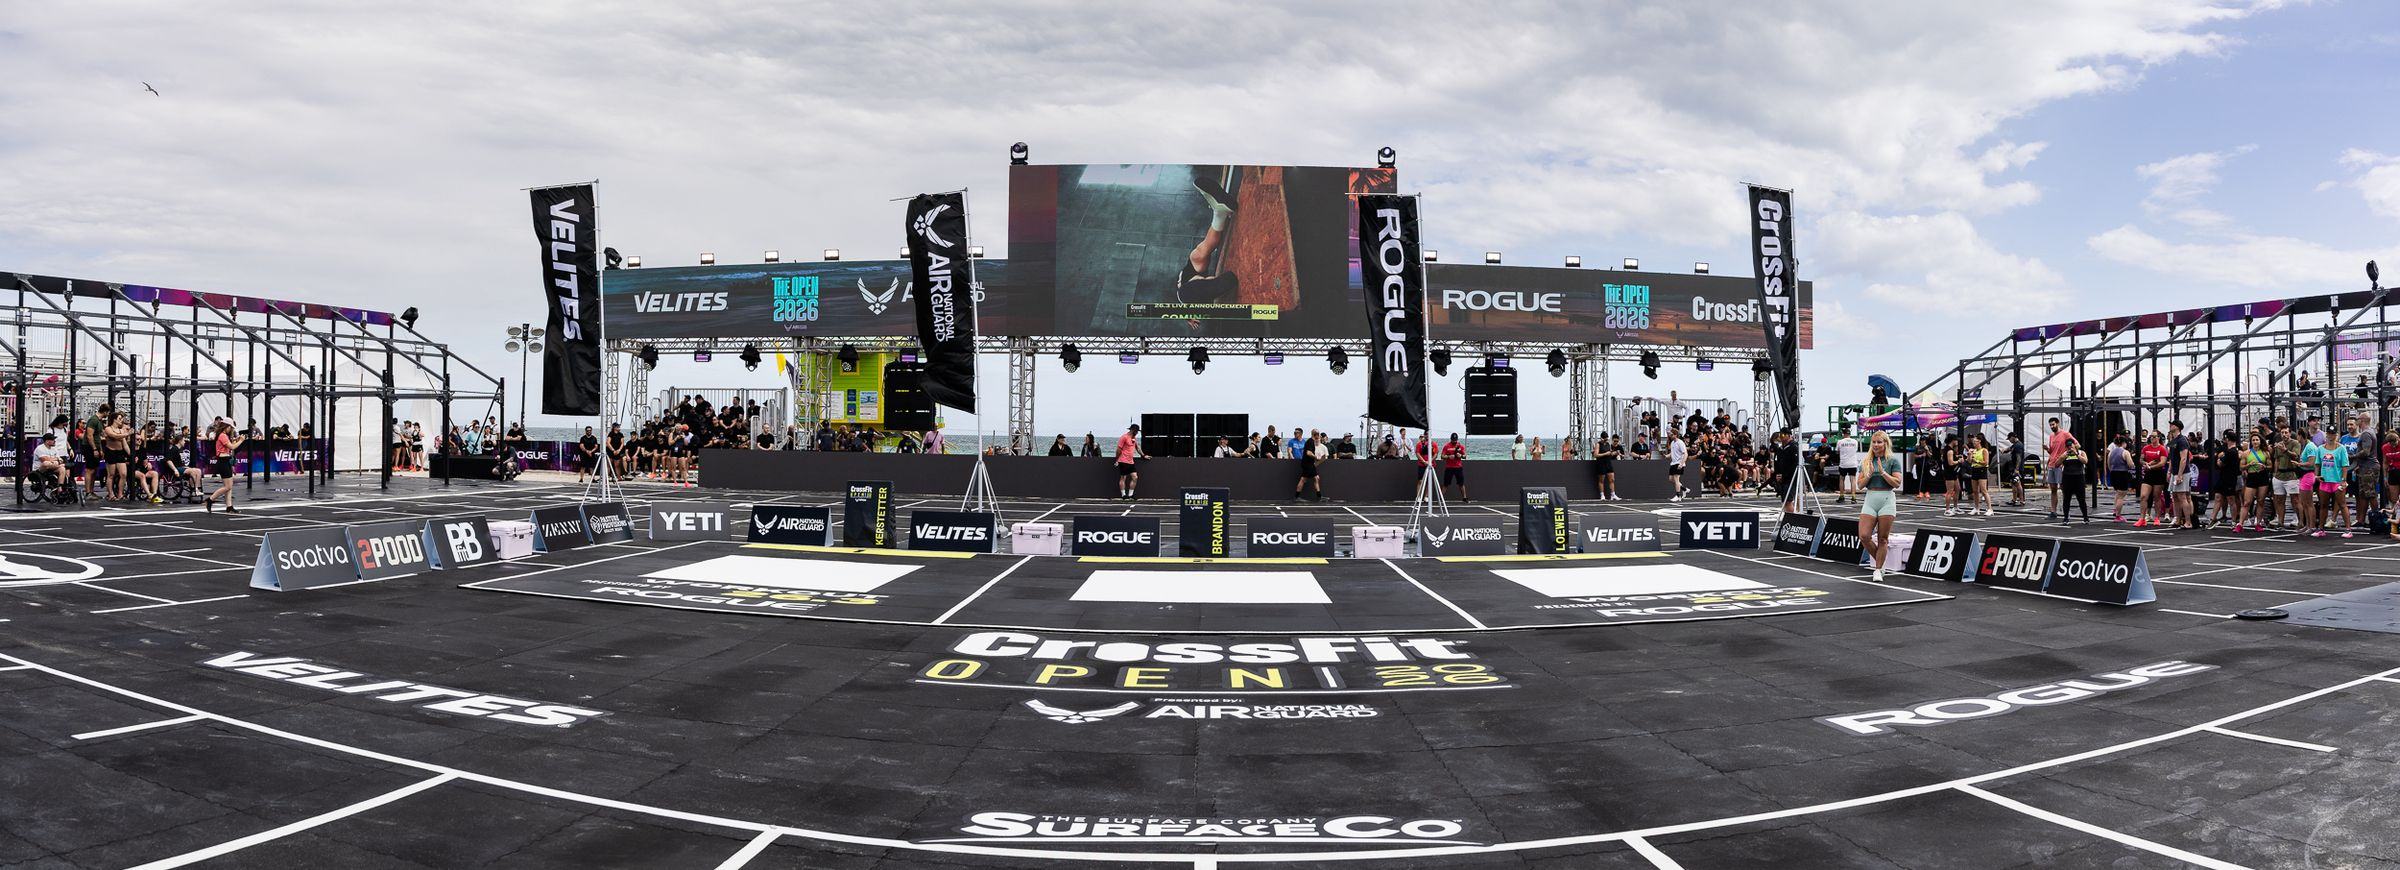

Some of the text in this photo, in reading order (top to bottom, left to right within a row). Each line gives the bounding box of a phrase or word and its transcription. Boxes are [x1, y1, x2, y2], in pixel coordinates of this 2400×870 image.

[550, 199, 583, 341] VELITES
[928, 252, 951, 295] AIR
[66, 280, 72, 292] 6
[792, 276, 819, 296] OPEN
[1377, 209, 1408, 372] ROGUE
[1623, 285, 1650, 304] OPEN
[633, 291, 728, 313] VELITES
[774, 299, 819, 322] 2026
[1442, 290, 1561, 313] ROGUE
[1692, 296, 1762, 322] CrossFi
[2244, 305, 2252, 316] 17
[931, 294, 946, 343] GUARD
[943, 294, 955, 342] NATIONAL
[1605, 306, 1650, 329] 2026
[516, 451, 549, 460] OGUE
[659, 512, 722, 531] YETI
[777, 517, 799, 530] AIR
[799, 524, 824, 532] GUARD
[875, 487, 888, 546] KERSTETTER
[1212, 501, 1224, 555] BRANDON
[915, 523, 987, 541] VELITES
[1078, 531, 1152, 544] ROGUE
[1253, 532, 1327, 545] ROGUE
[1452, 528, 1474, 541] AIR
[1474, 533, 1501, 541] GUARD
[1554, 507, 1566, 551] LOEWEN
[1586, 527, 1655, 542] VELITES
[1688, 521, 1750, 540] YETI
[278, 544, 348, 570] saatva
[357, 534, 424, 569] 2POOD
[1981, 546, 2047, 581] 2POOD
[2057, 558, 2128, 584] saatva
[590, 586, 818, 611] ROGUE
[1597, 597, 1822, 617] ROGUE
[953, 632, 1471, 664] CrossFit
[925, 659, 1285, 688] OPEN
[203, 651, 604, 726] VELITES
[1826, 661, 2211, 734] ROGUE
[1145, 705, 1252, 719] AIR
[1253, 710, 1378, 719] GUARD
